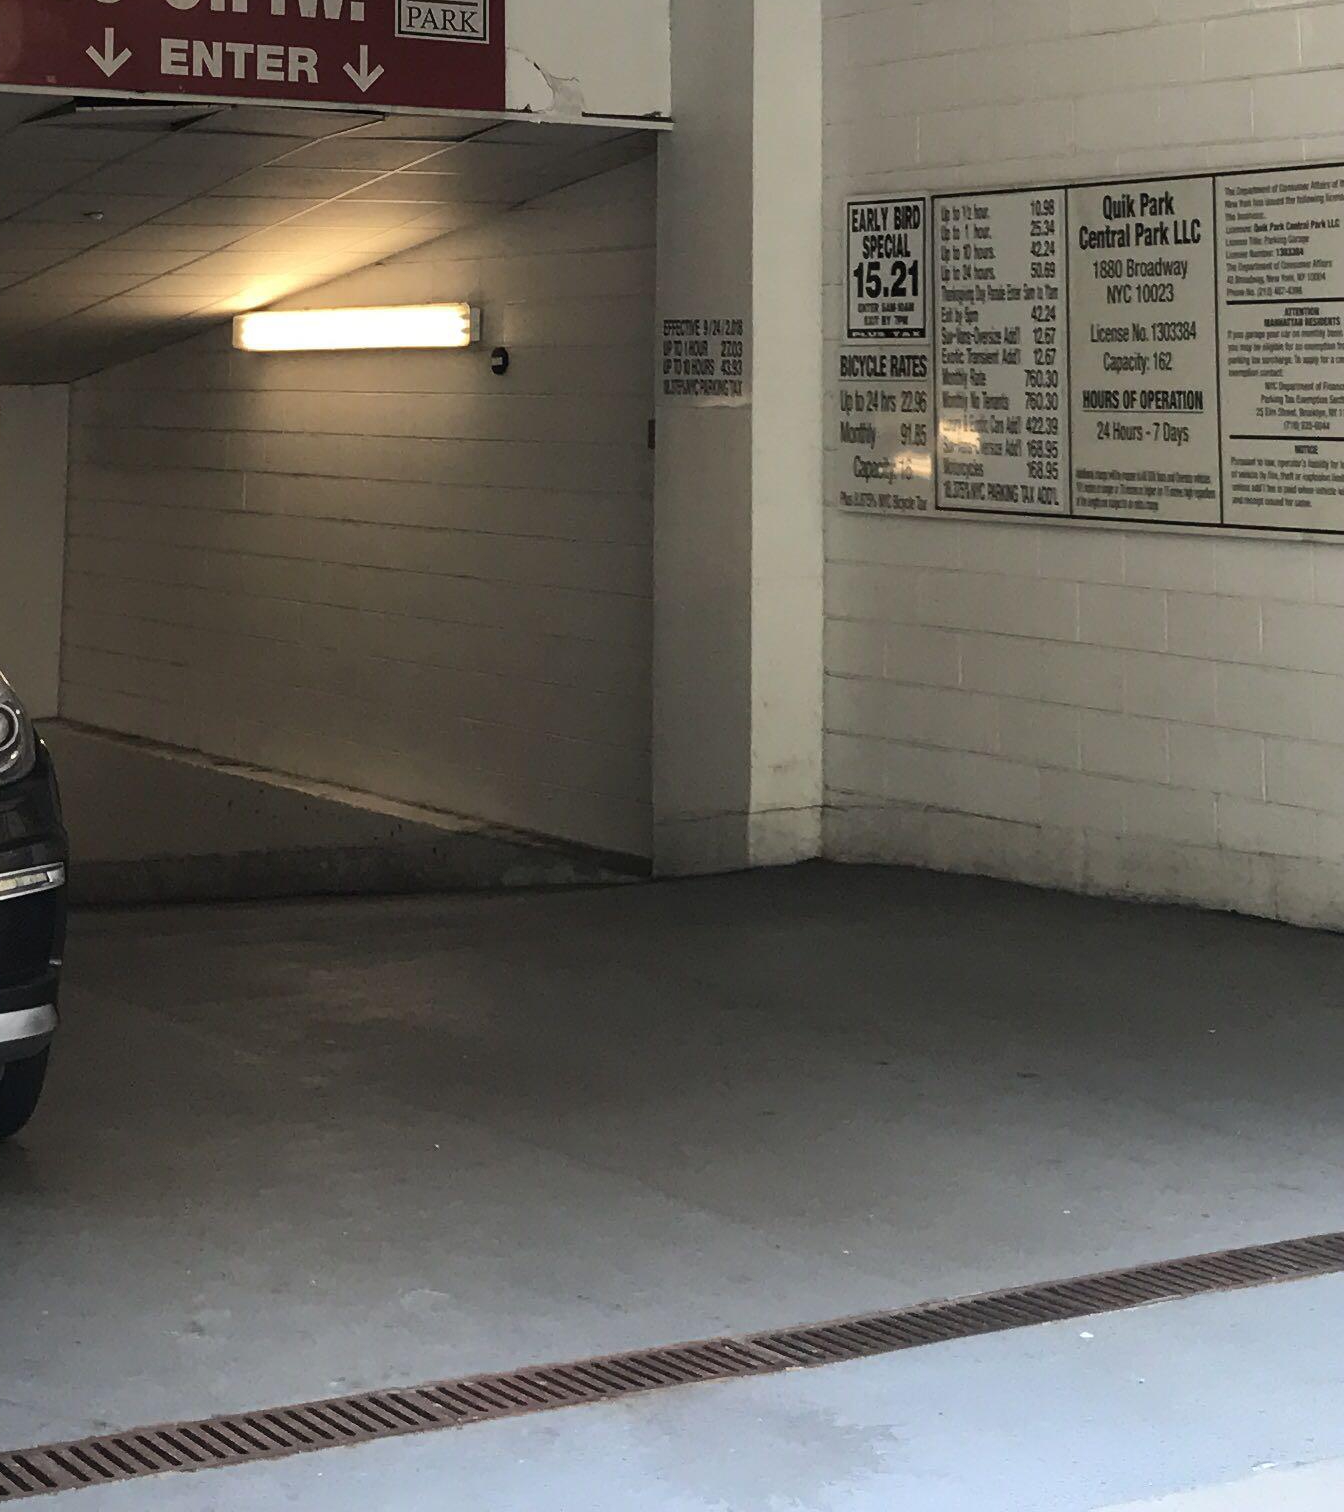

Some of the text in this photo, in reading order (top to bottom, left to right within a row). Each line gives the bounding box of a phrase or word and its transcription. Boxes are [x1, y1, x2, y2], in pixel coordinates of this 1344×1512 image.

[406, 6, 479, 33] PARK
[160, 38, 319, 84] ENTER
[1102, 191, 1175, 220] Quik Park
[851, 205, 921, 233] EARLY BIRD
[862, 234, 911, 259] SPECIAL
[1079, 218, 1201, 250] Central Park LLC
[853, 260, 918, 299] 15.21
[1092, 257, 1188, 280] 1880 Broadway
[1106, 283, 1174, 304] NYC 10023
[1090, 321, 1197, 343] License No. 1303384
[840, 354, 928, 378] BICYCLE RATES
[1103, 351, 1172, 375] Capacity: 162
[1082, 390, 1204, 410] HOURS OF OPERATION
[1096, 421, 1111, 440] 24
[1112, 421, 1143, 441] Hours
[1152, 422, 1160, 441] 7
[1163, 422, 1189, 446] Days
